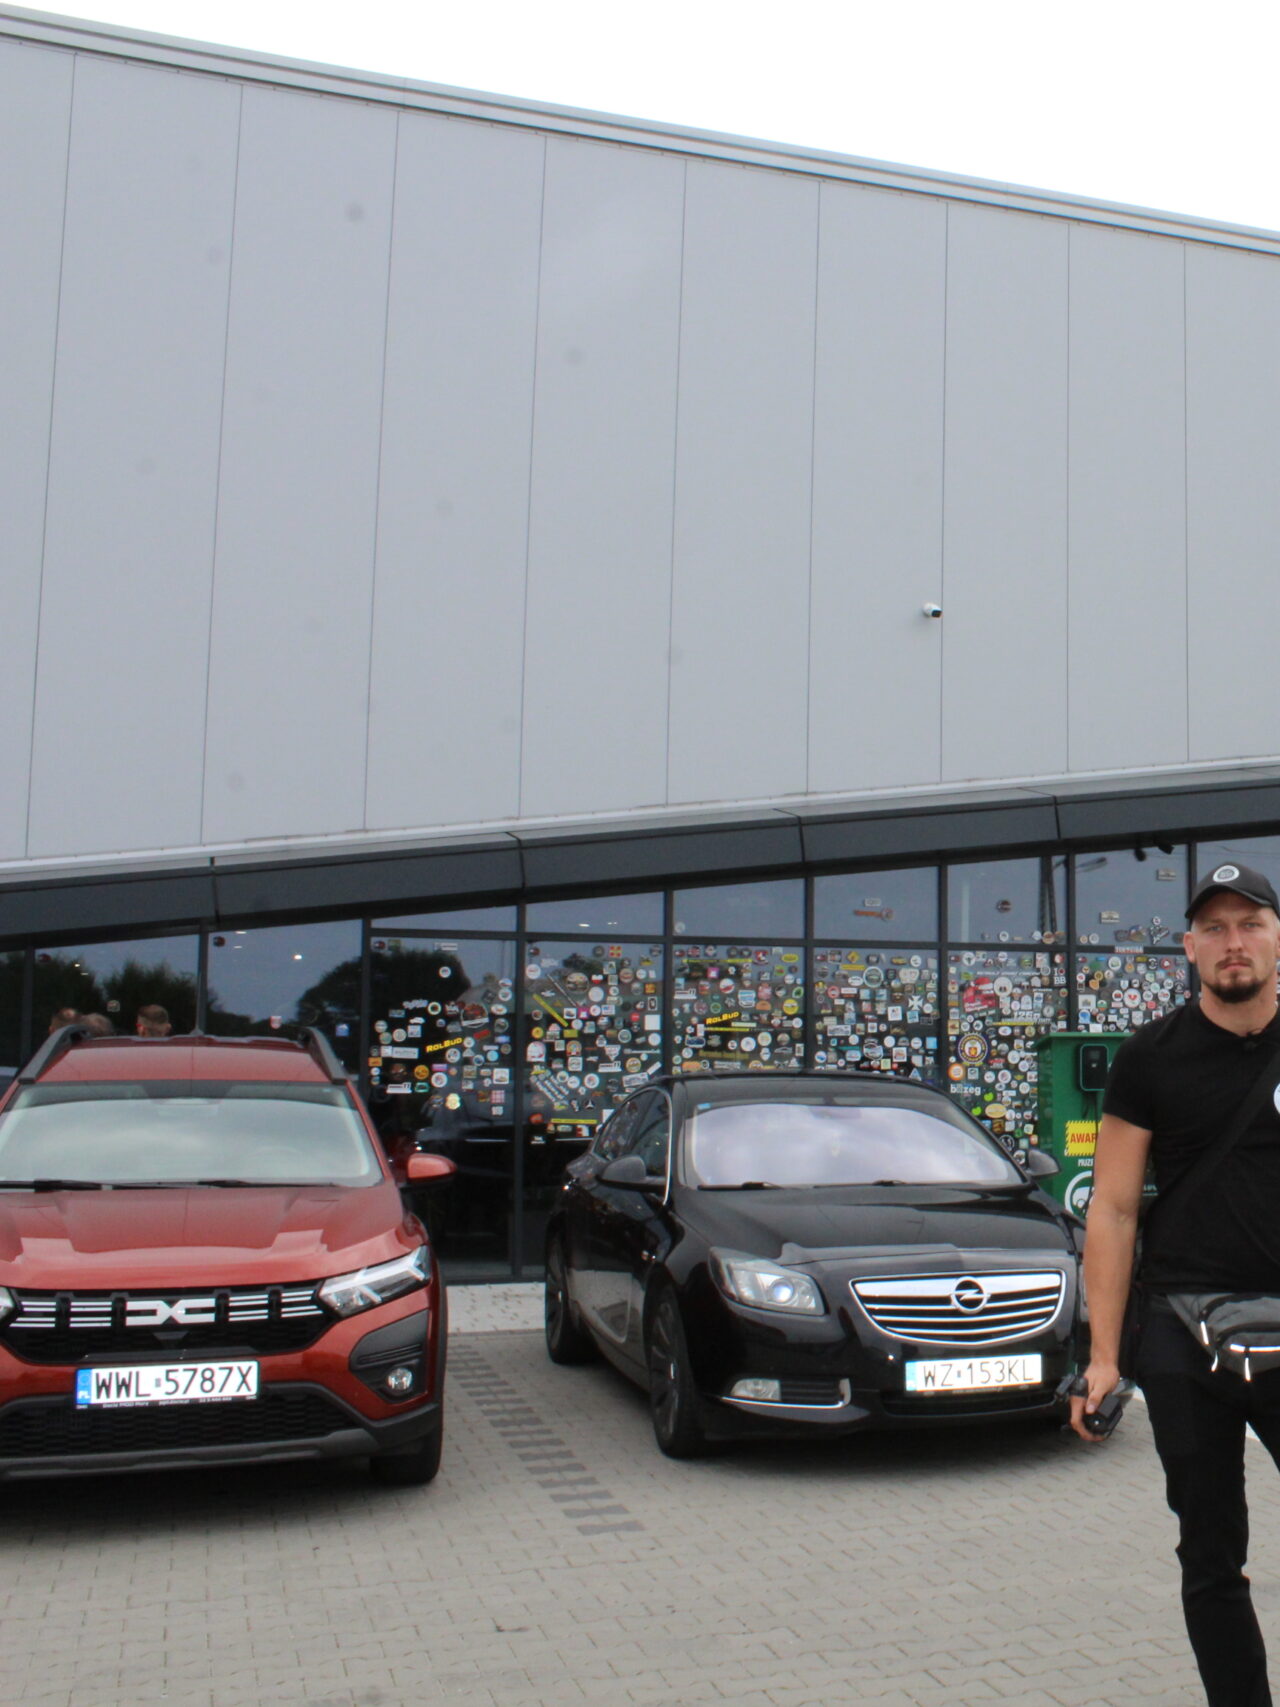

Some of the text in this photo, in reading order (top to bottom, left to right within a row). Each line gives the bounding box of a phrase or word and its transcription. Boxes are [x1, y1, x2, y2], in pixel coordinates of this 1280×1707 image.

[95, 1365, 253, 1400] WWL 5787X
[923, 1359, 1034, 1388] WZ 153KL
